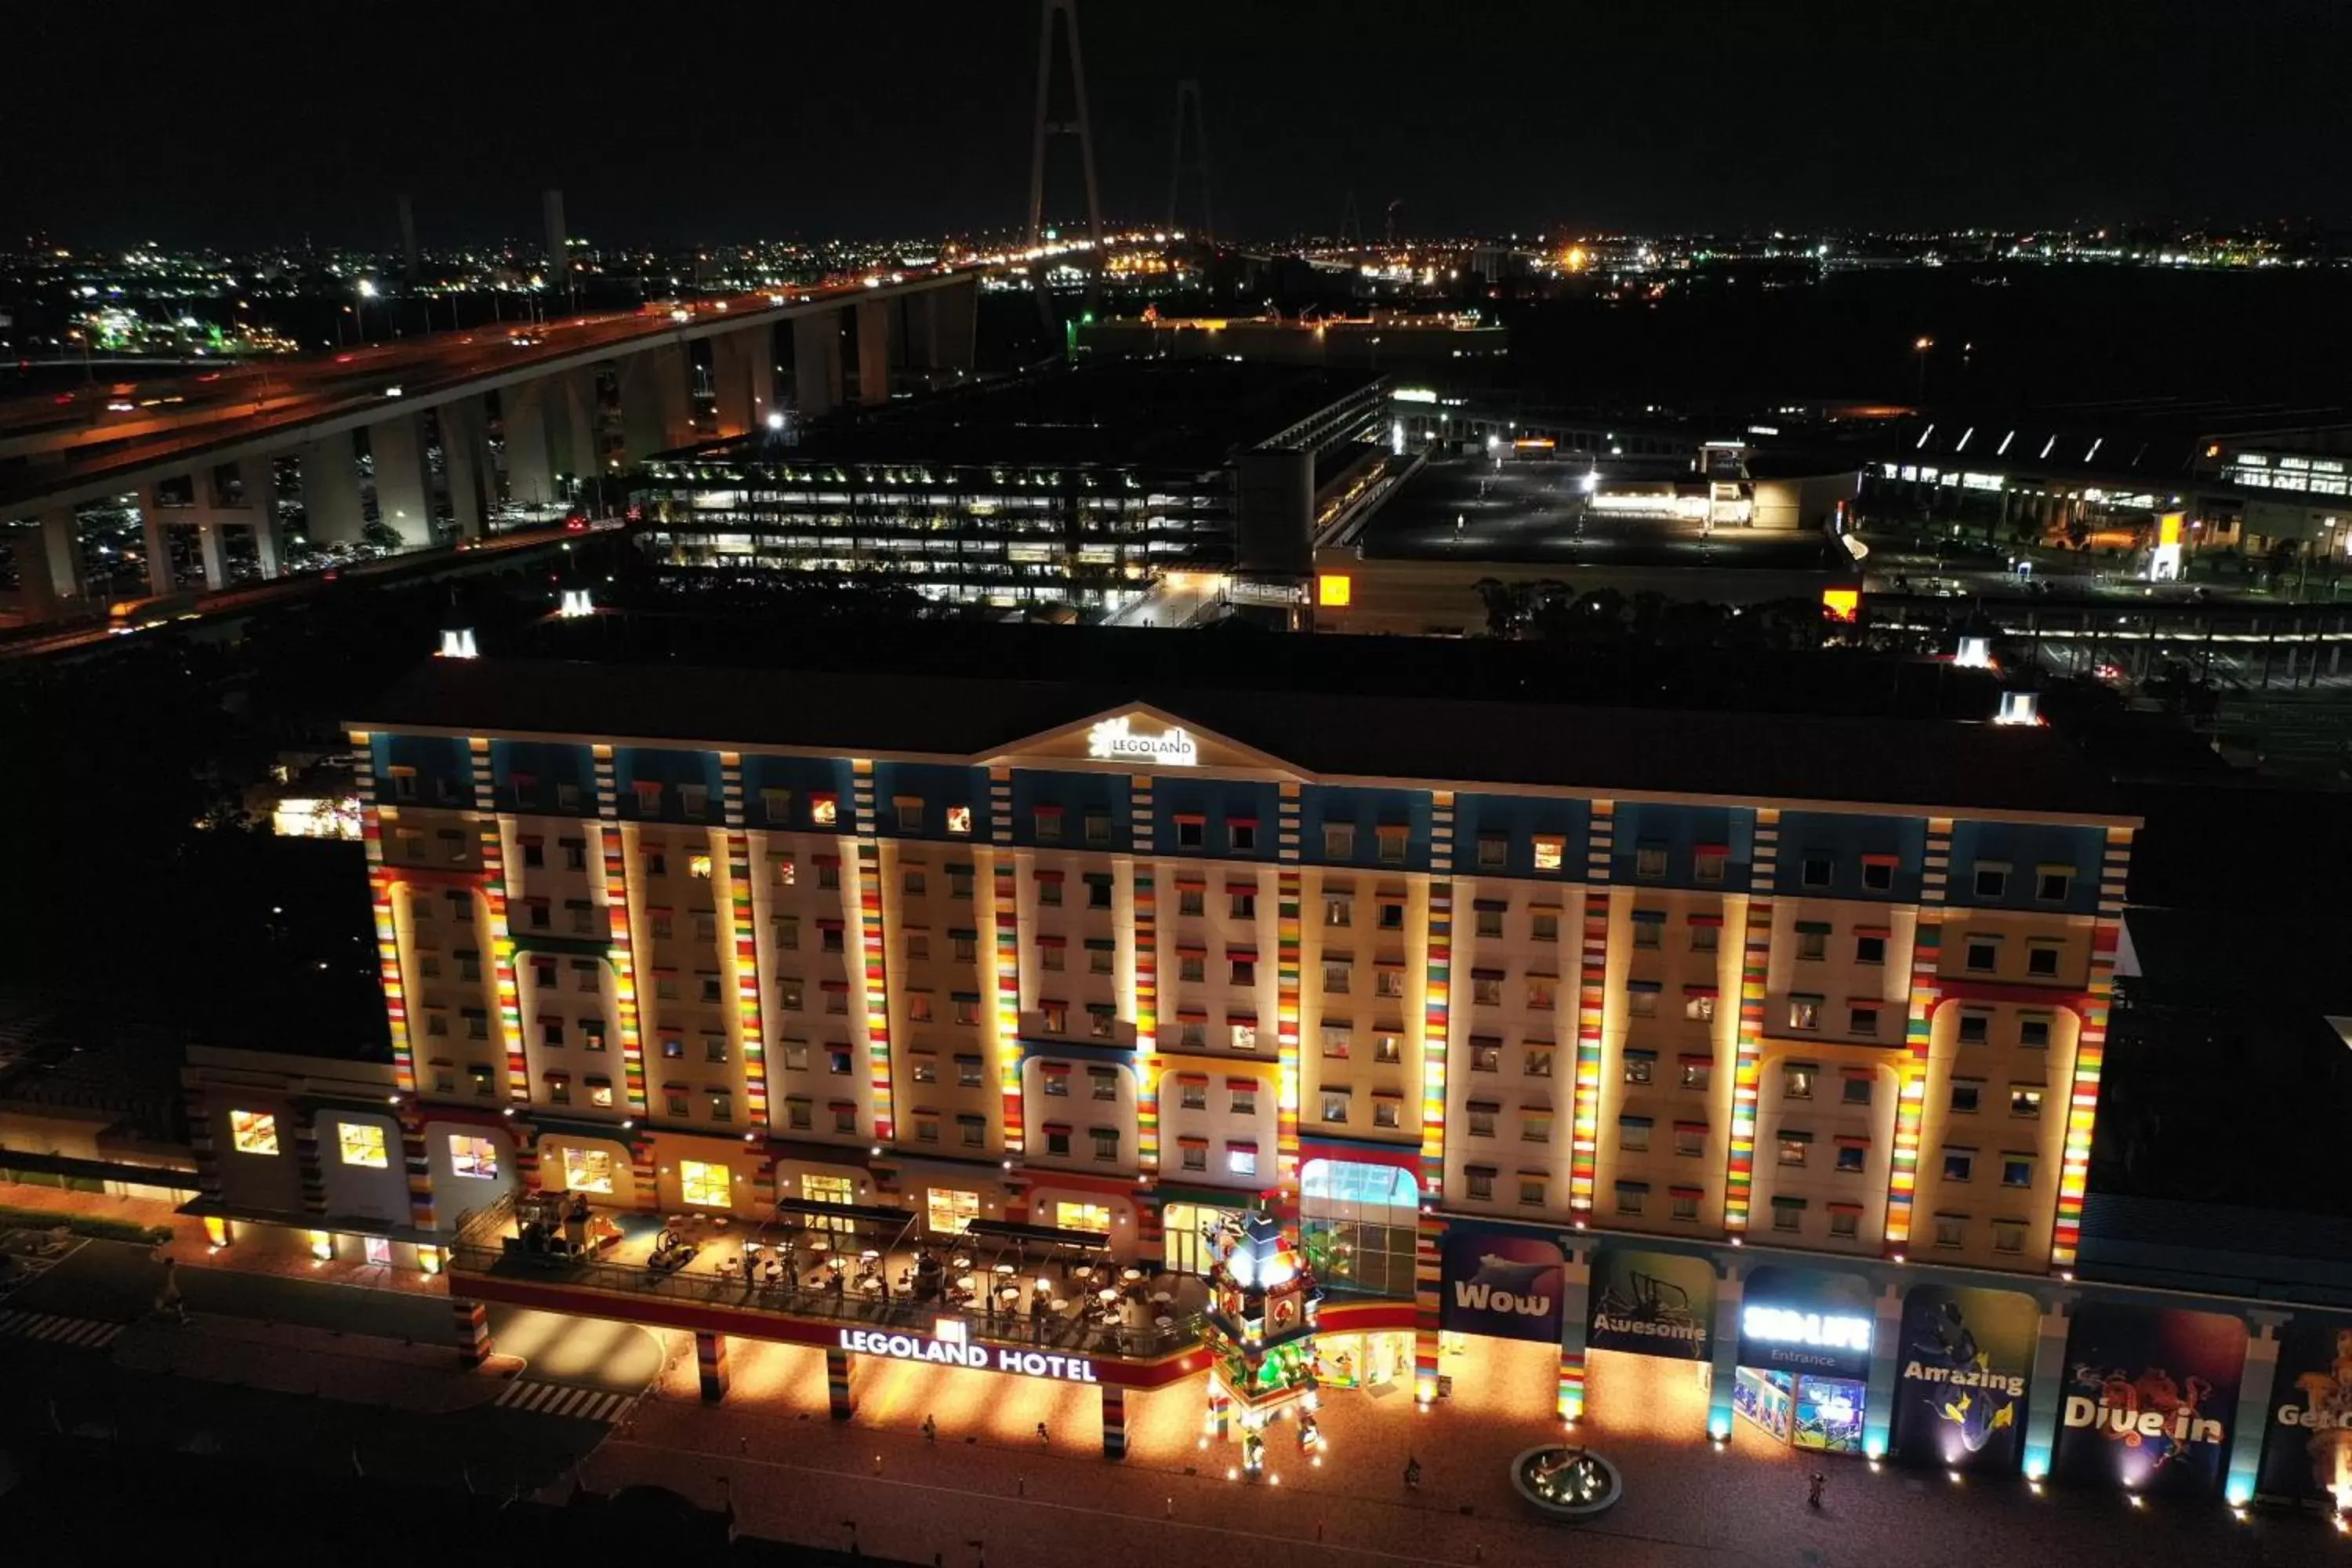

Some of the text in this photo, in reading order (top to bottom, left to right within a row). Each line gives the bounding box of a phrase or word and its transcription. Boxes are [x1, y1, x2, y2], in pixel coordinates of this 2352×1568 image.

[1113, 730, 1192, 753] LEGOLAND
[1455, 1280, 1551, 1316] Wow
[1594, 1312, 1707, 1342] Awesome
[840, 1321, 1098, 1382] LEGOLAND HOTEL
[1771, 1348, 1836, 1367] Entrance
[1904, 1360, 2025, 1396] Amazing
[2063, 1396, 2222, 1444] Dive in
